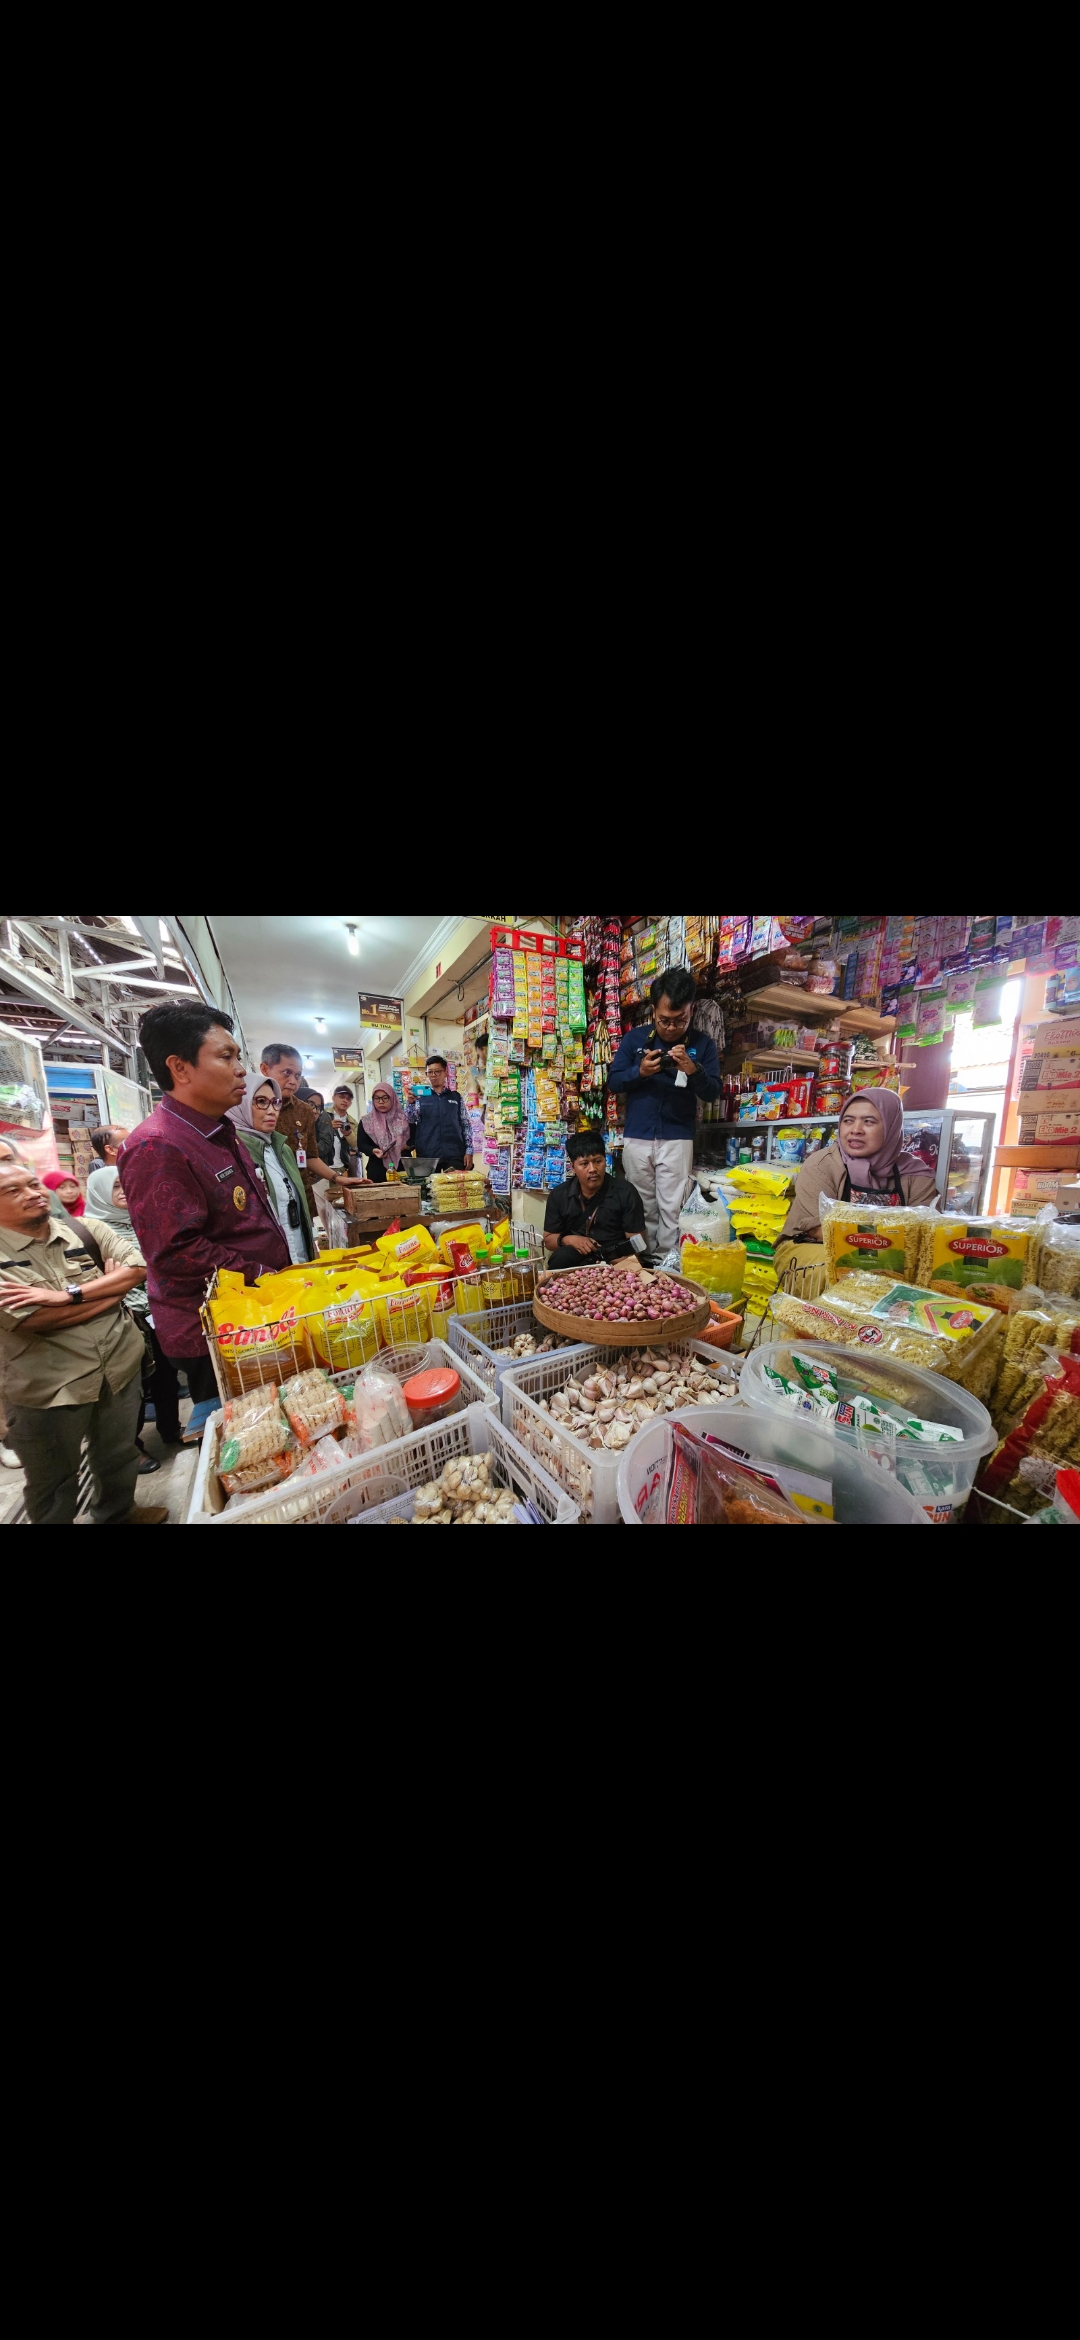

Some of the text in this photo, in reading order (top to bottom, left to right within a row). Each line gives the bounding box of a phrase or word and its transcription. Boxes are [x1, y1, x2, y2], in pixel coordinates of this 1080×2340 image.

[370, 1003, 378, 1016] 1
[848, 1235, 888, 1247] SUPERIOR
[952, 1241, 1003, 1254] SUPERIOR
